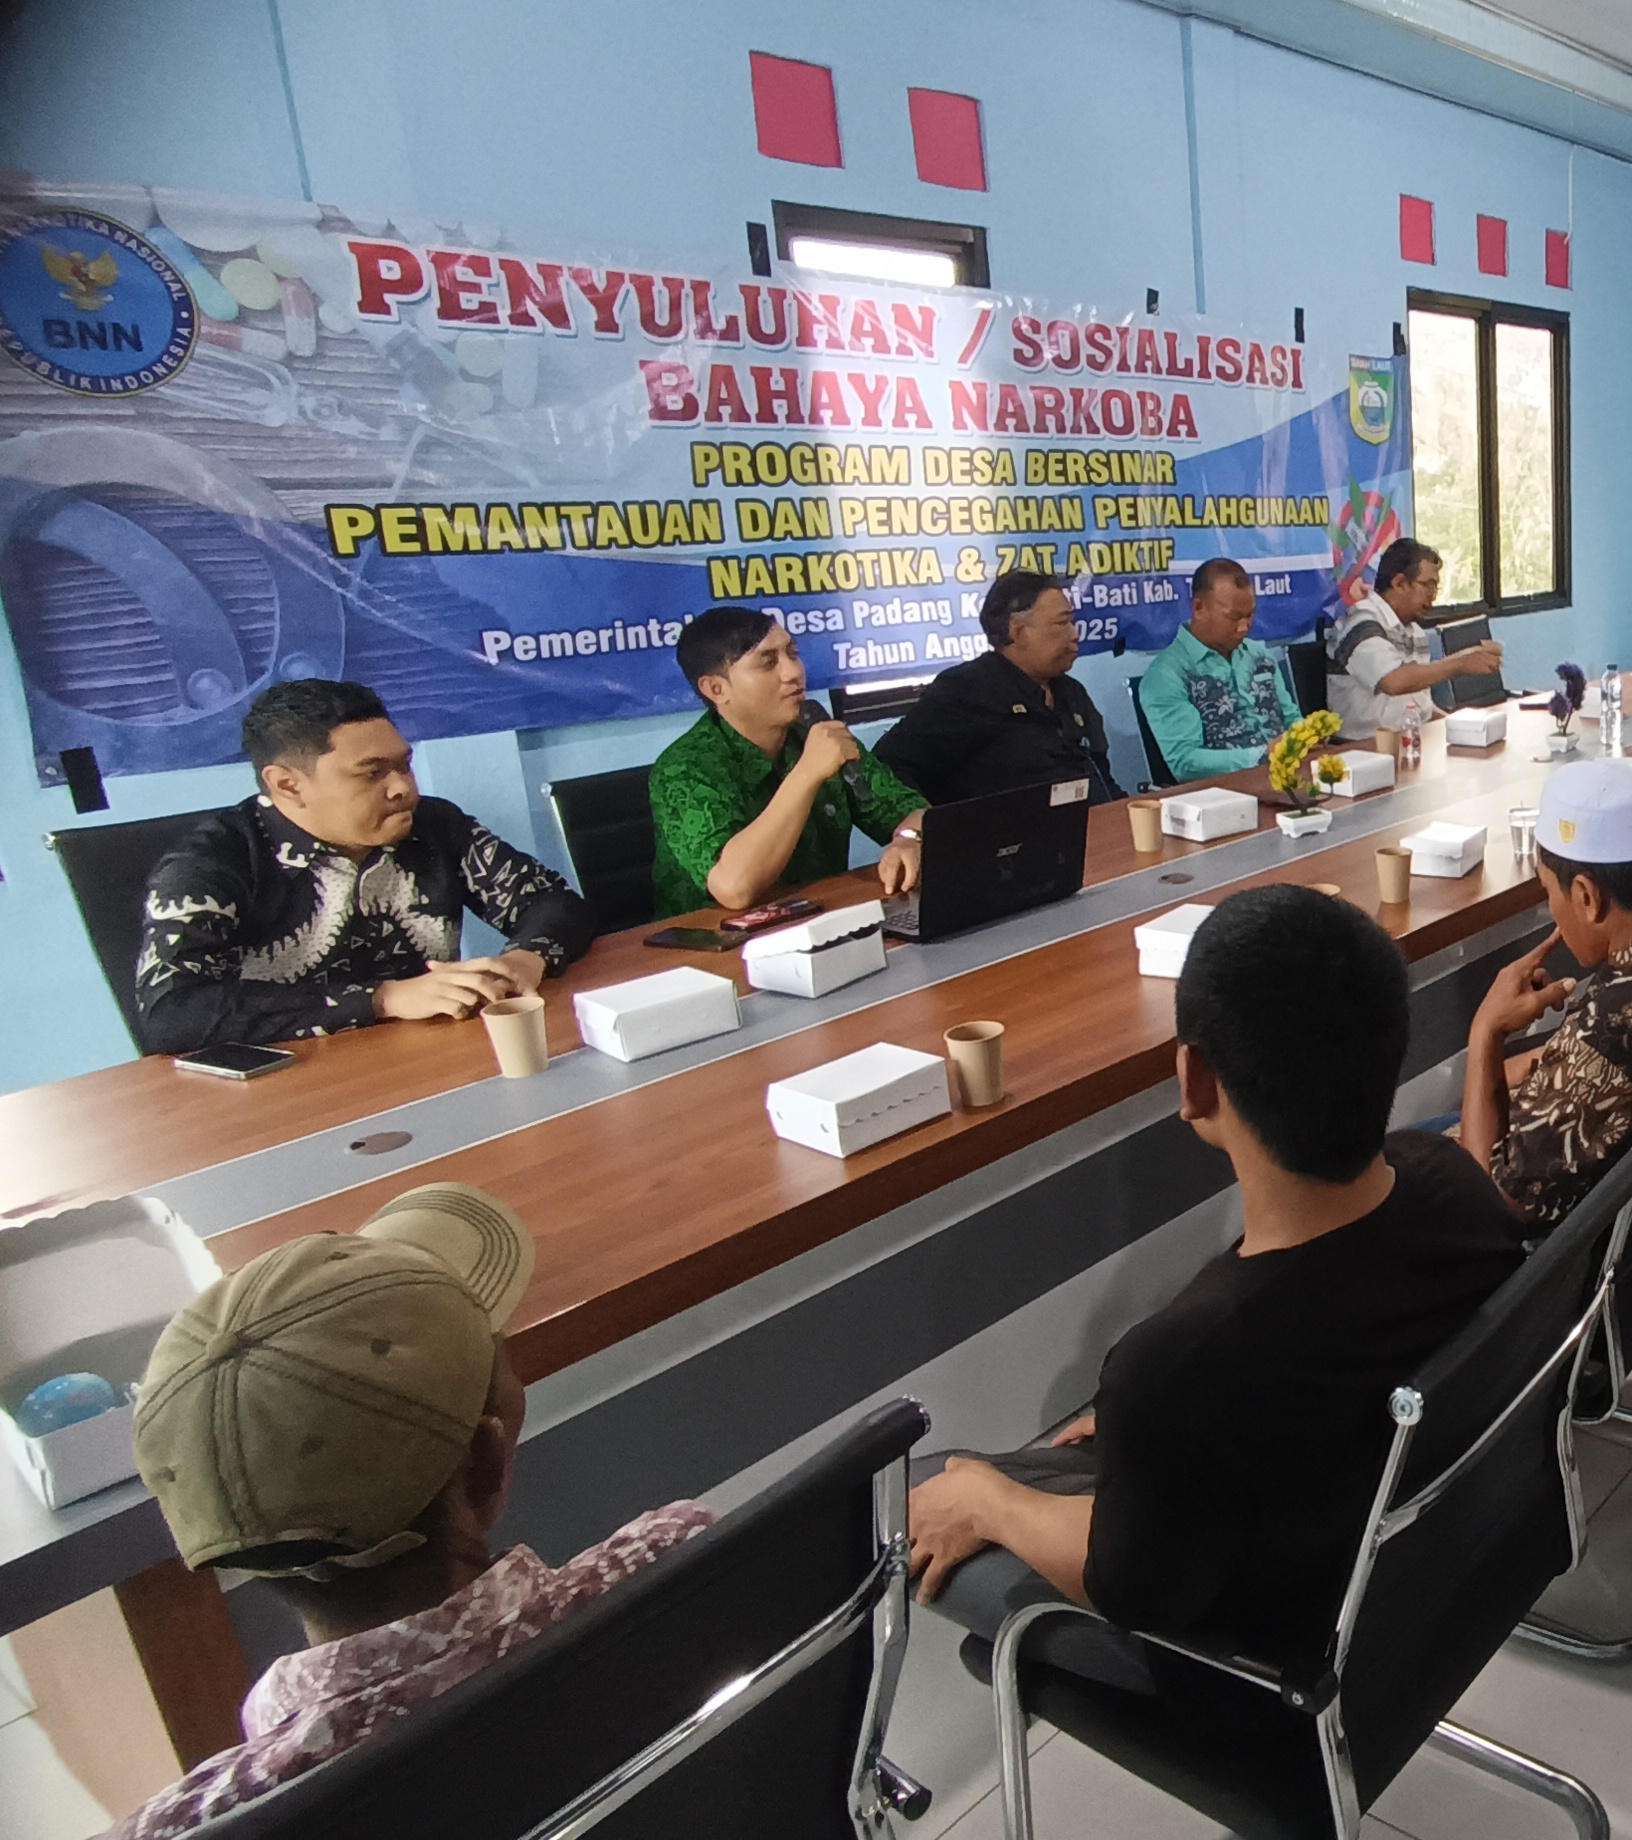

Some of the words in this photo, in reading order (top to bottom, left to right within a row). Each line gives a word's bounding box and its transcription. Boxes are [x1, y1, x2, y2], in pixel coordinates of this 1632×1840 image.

[113, 230, 187, 301] NASIONAL
[42, 318, 143, 352] BNN
[346, 240, 938, 360] PENYULUHAN
[956, 308, 992, 365] /
[1010, 314, 1305, 390] SOSIALISASI
[100, 327, 193, 391] INDONESIA
[637, 358, 935, 431] BAHAYA
[947, 378, 1200, 438] NARKOBA
[691, 441, 911, 487] PROGRAM
[922, 445, 1016, 486] DESA
[1025, 446, 1177, 487] BERSINAR
[325, 498, 726, 558] PEMANTAUAN
[736, 497, 832, 542] DAN
[839, 495, 1085, 537] PENCEGAHAN
[1093, 495, 1331, 528] PENYALAHGUNAAN
[707, 546, 945, 598] NARKOTIKA
[954, 546, 987, 584] &
[996, 543, 1058, 576] ZAT
[1067, 538, 1175, 576] ADIKTIF
[482, 613, 694, 666] Pemerinta
[852, 597, 952, 629] Padang
[1143, 577, 1179, 602] Kab.
[1254, 573, 1292, 596] Laut
[833, 640, 915, 670] Tahun
[1075, 617, 1119, 643] 025
[996, 843, 1023, 857] acer
